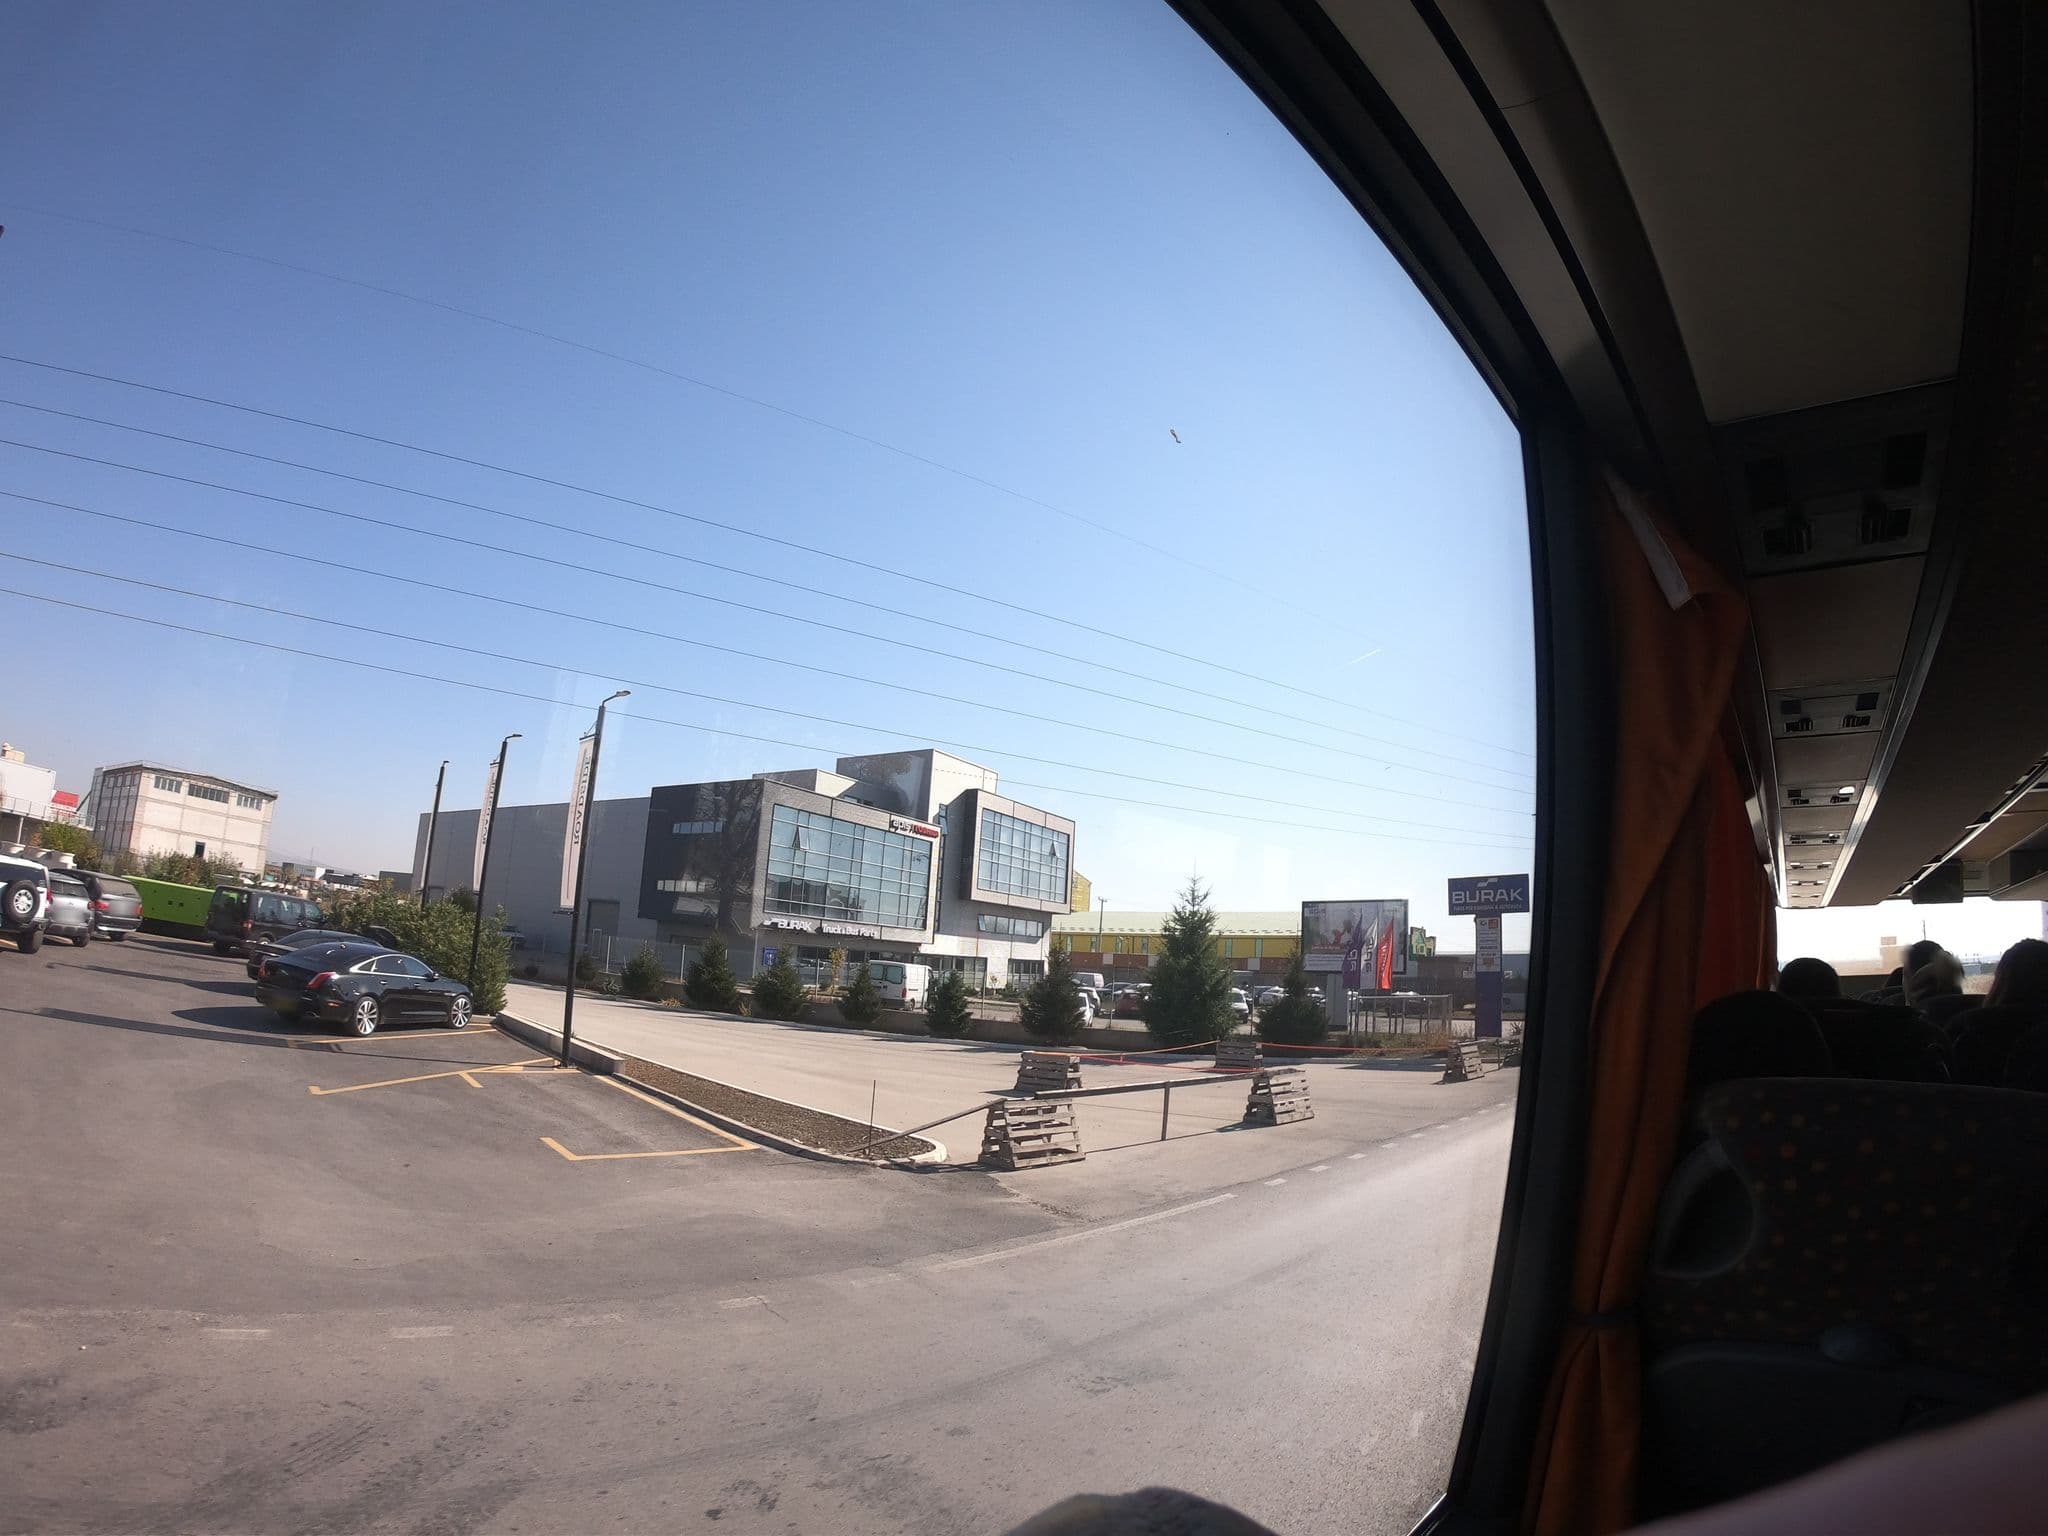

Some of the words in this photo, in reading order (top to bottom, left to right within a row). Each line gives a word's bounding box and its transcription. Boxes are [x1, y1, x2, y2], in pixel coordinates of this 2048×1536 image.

[1452, 888, 1523, 904] BURAK
[777, 918, 812, 931] BURAK
[821, 923, 841, 934] Truck
